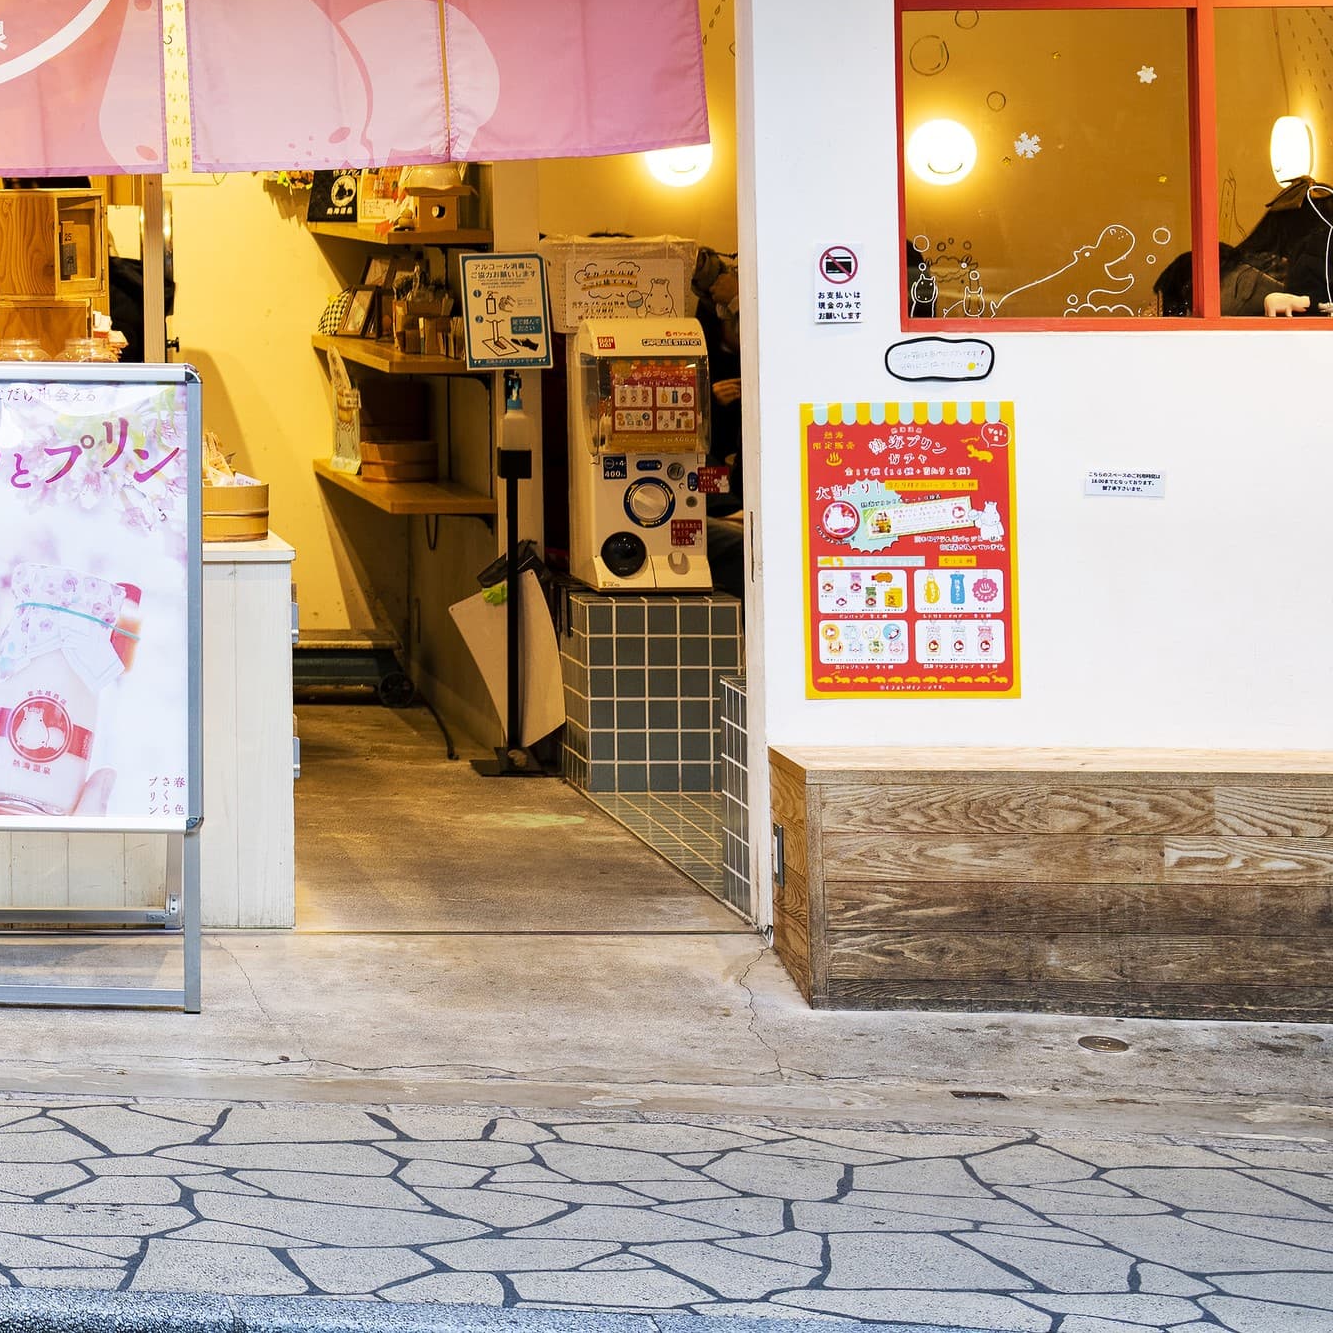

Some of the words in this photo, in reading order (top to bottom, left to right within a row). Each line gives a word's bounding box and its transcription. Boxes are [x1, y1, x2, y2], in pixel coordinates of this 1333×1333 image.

[470, 270, 537, 279] ご協力お願いします
[817, 291, 862, 299] お支払いは
[817, 301, 862, 310] 現金のみで
[817, 311, 862, 320] お願いします
[816, 481, 882, 501] 大当たり!
